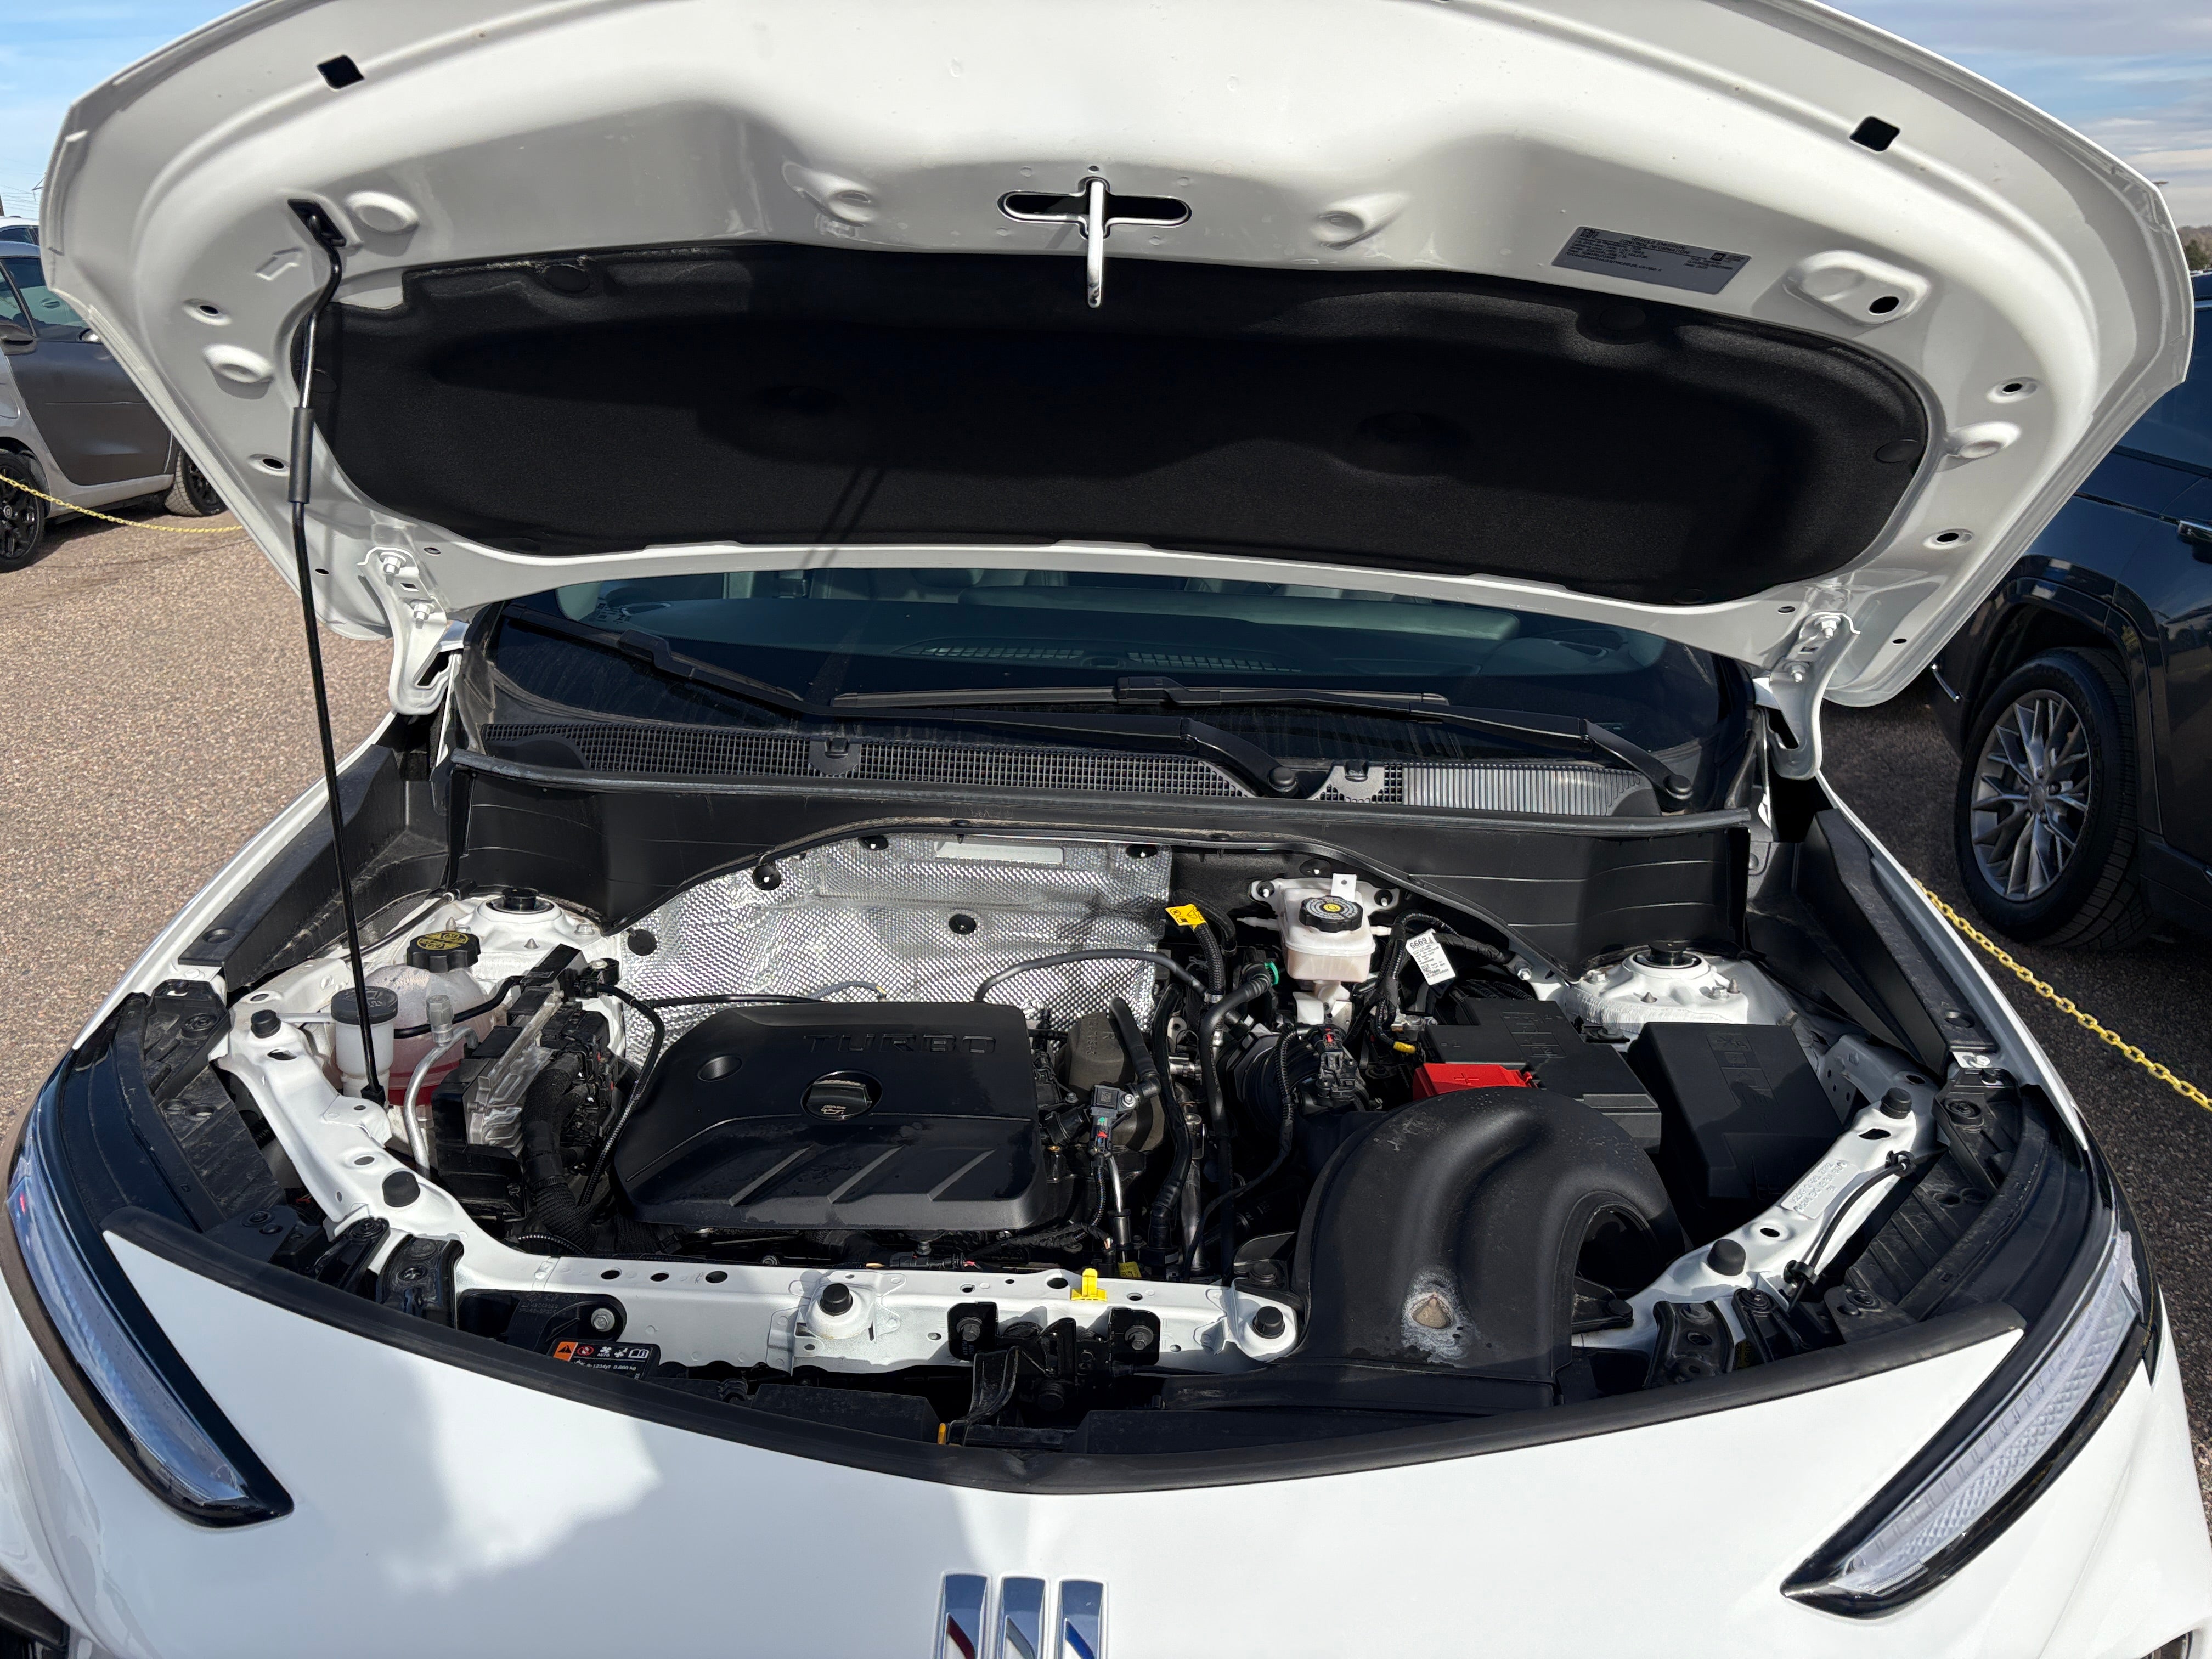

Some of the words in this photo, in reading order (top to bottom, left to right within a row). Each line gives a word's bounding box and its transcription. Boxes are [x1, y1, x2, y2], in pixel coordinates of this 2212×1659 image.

[1619, 239, 1647, 247] CONTROL
[1631, 236, 1656, 245] VEHICLE
[1409, 937, 1427, 949] 6669
[803, 1033, 997, 1054] TURBO
